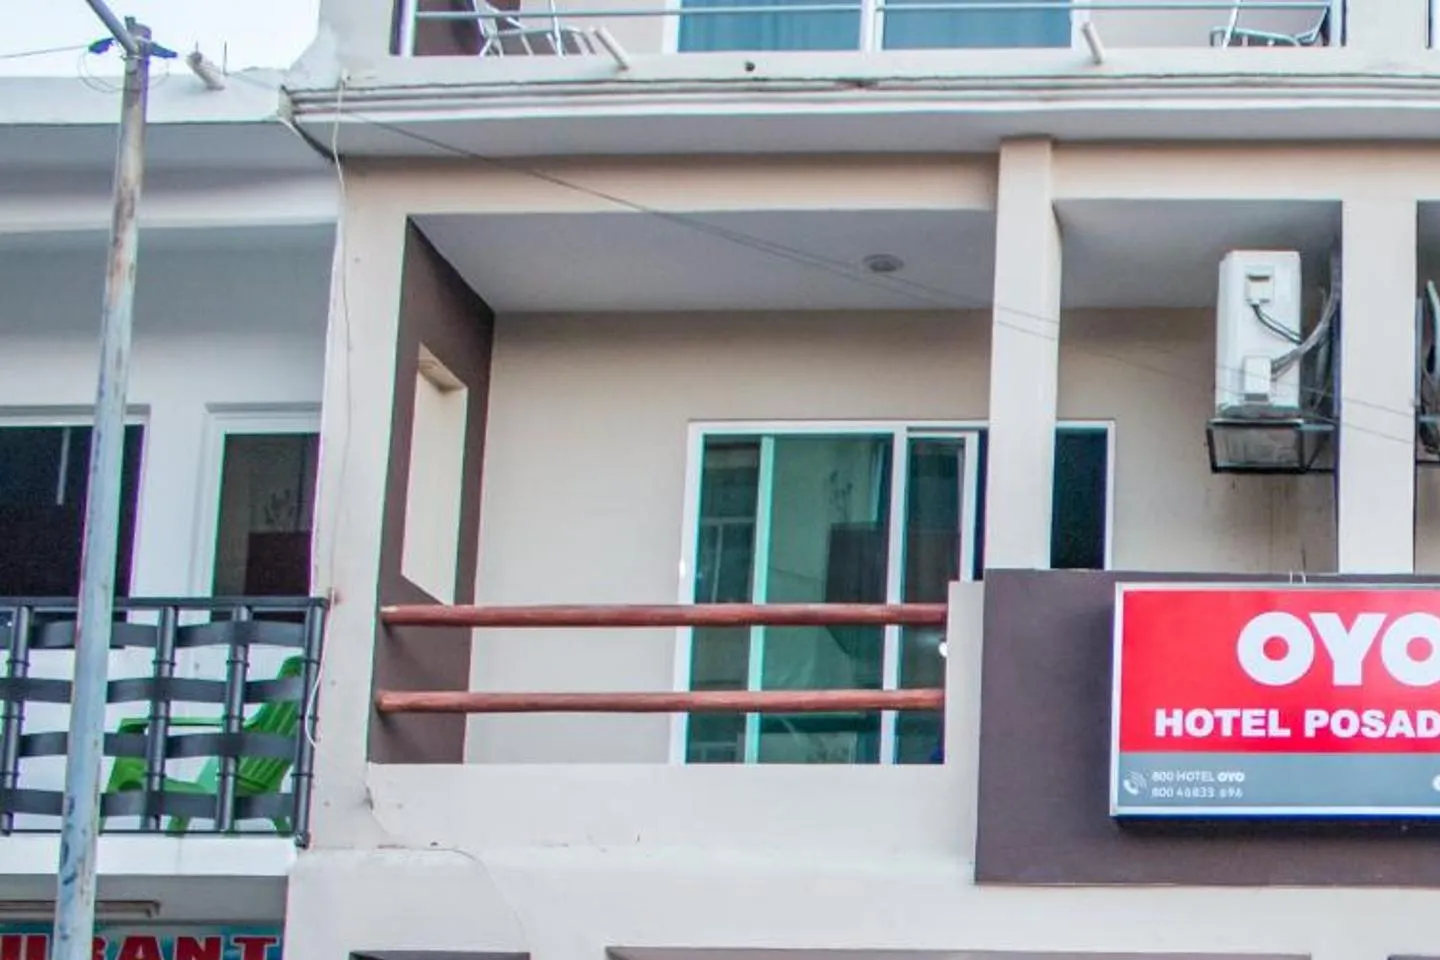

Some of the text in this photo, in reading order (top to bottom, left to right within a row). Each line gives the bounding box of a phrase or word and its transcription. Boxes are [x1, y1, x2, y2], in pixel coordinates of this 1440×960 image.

[1154, 708, 1291, 738] HOTEL
[1152, 771, 1246, 782] 800 HOTEL OYO
